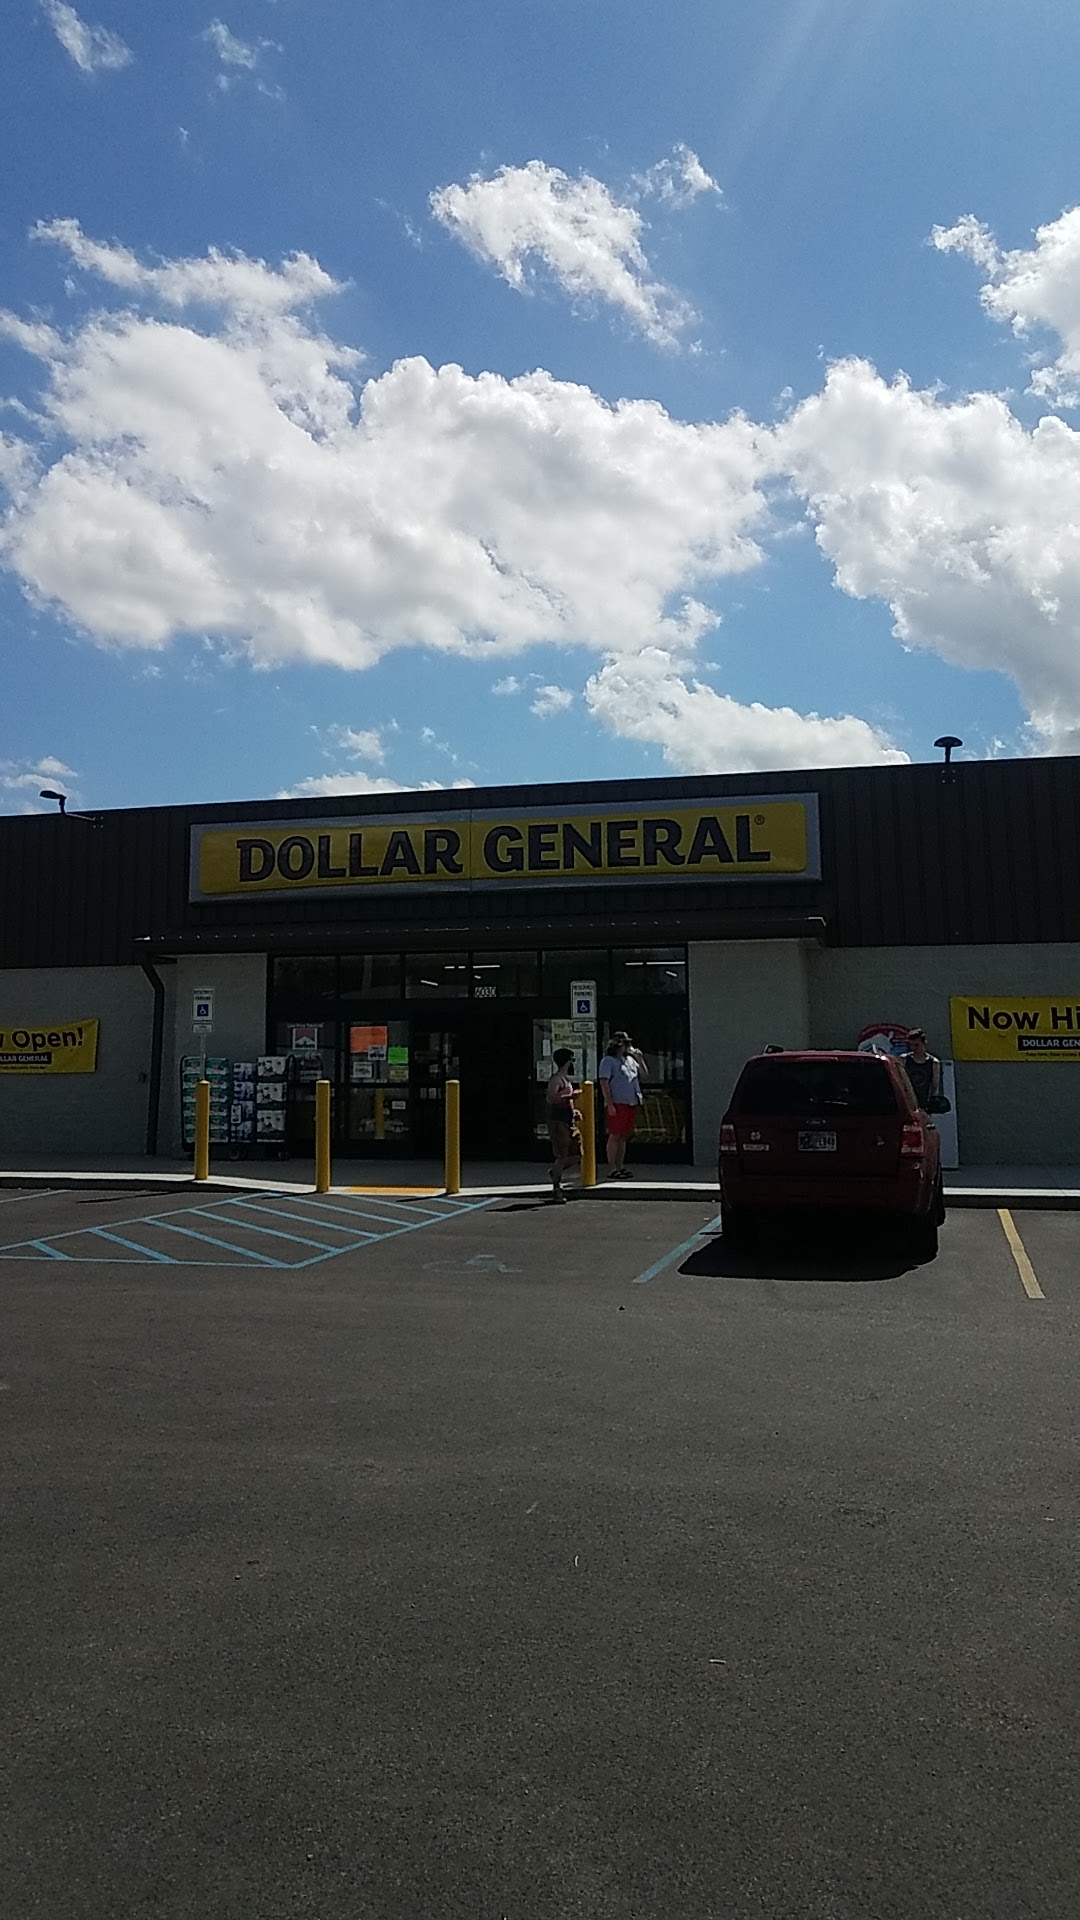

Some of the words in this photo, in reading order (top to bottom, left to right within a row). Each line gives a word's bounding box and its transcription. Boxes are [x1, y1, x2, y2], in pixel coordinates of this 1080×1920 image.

[237, 829, 463, 881] DOLLAR
[484, 815, 770, 872] GENERAL
[475, 986, 496, 998] 6030
[968, 1006, 1039, 1030] Now
[12, 1027, 83, 1052] Open!
[1022, 1039, 1060, 1047] DOLLAR
